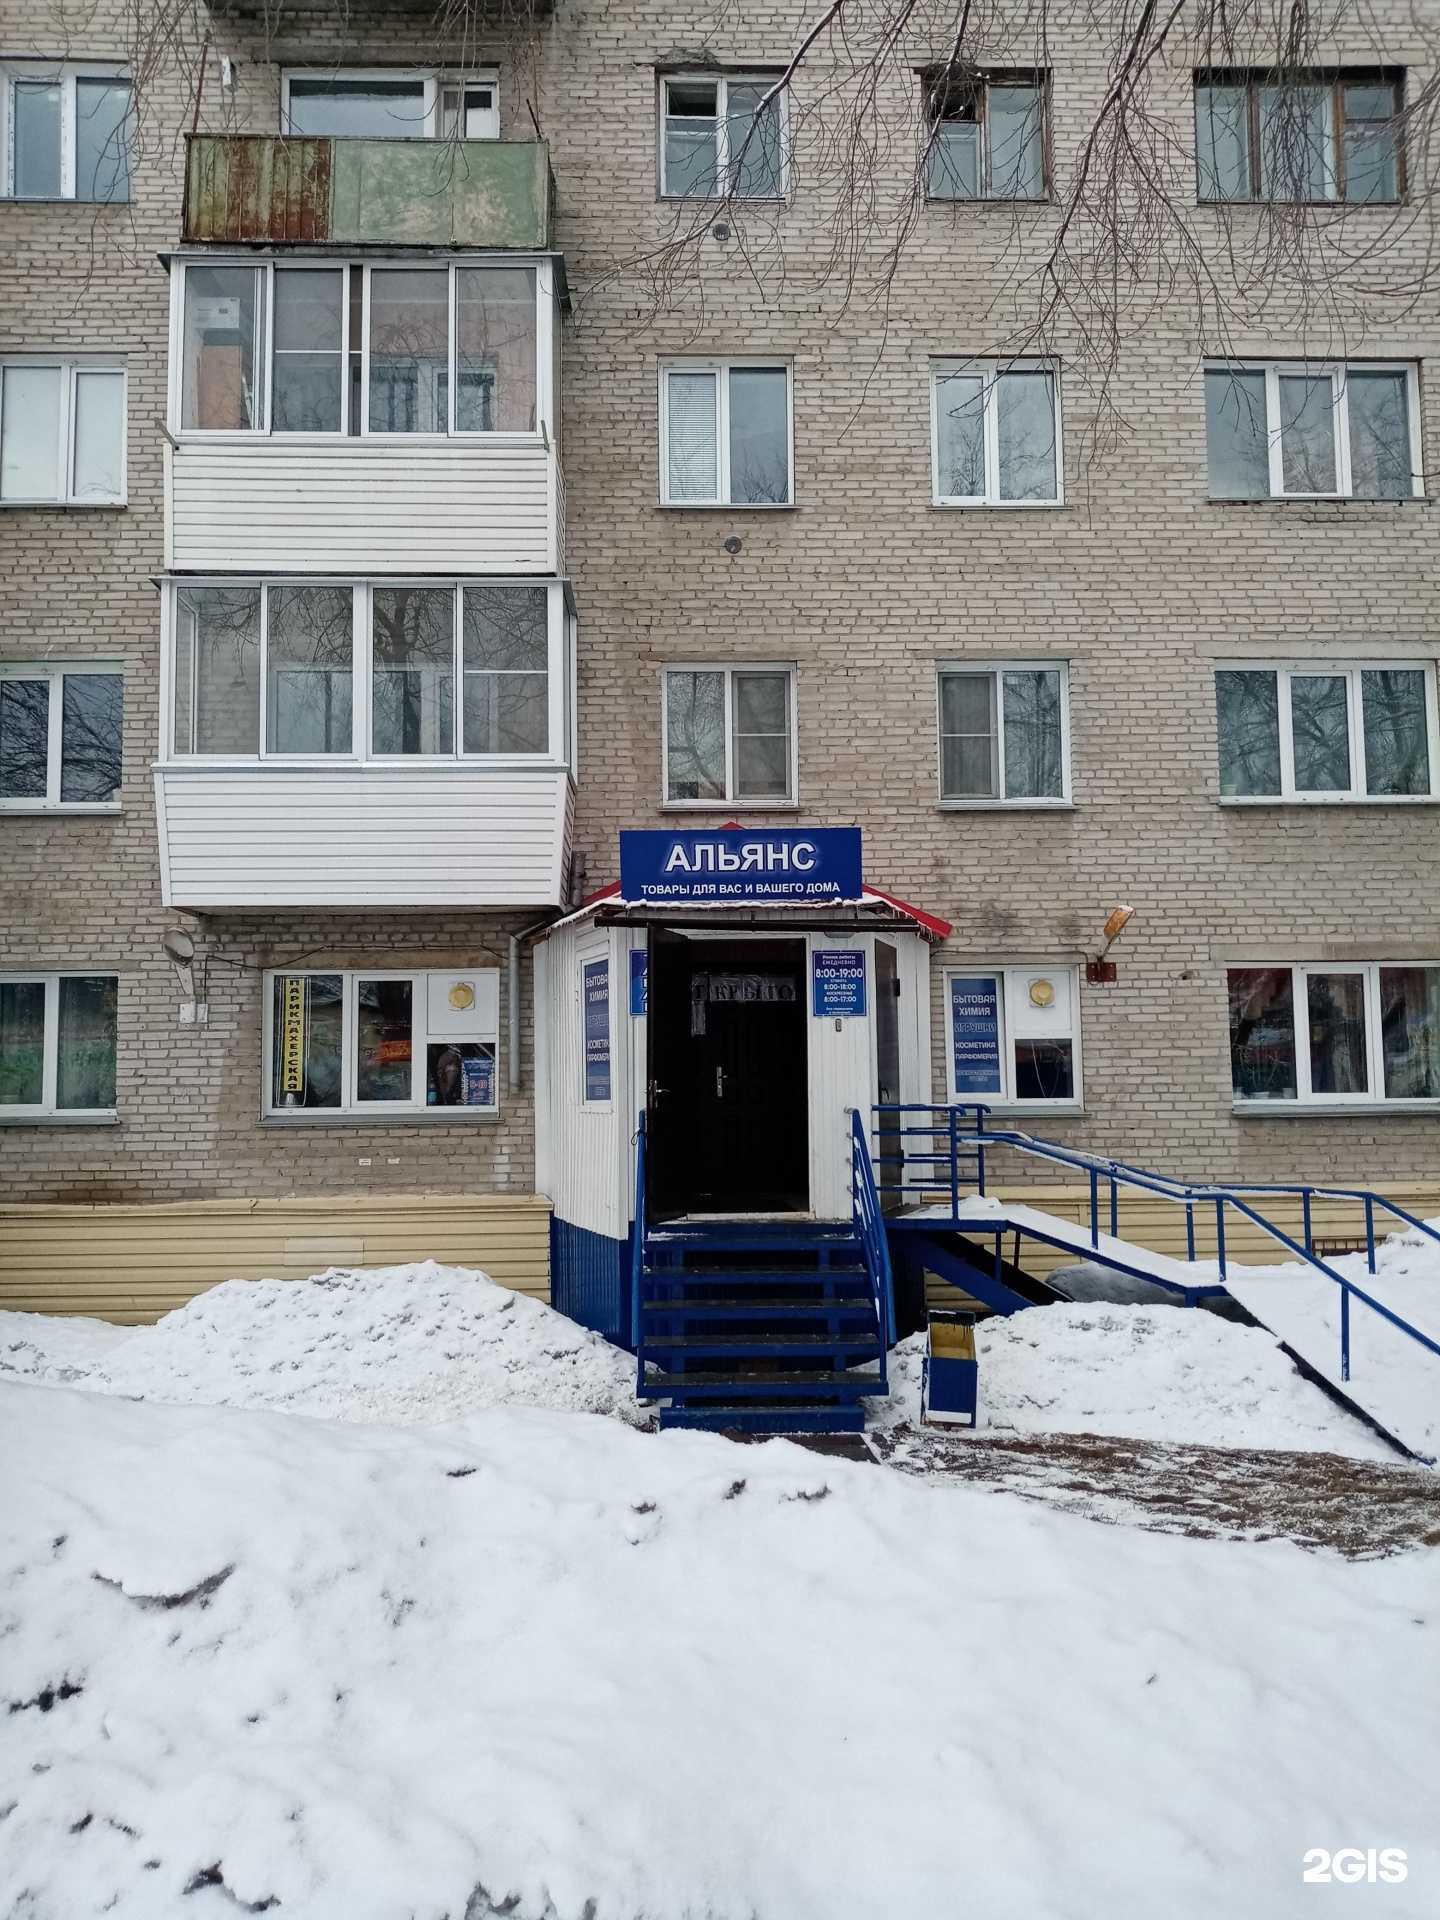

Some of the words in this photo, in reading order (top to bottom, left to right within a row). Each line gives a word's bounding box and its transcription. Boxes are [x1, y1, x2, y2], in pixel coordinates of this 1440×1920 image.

[665, 843, 816, 872] АЛЬЯНС
[641, 884, 690, 895] ТОВАРЫ
[692, 884, 716, 896] ДЛЯ
[719, 884, 742, 894] ВАС
[745, 883, 753, 893] И
[756, 883, 804, 893] ВАШЕГО
[806, 882, 840, 894] ДОМА
[816, 968, 863, 978] 8:00-19:00
[586, 974, 608, 988] БЫТОВА
[953, 995, 996, 1004] БЫТОВАЯ
[958, 1007, 991, 1016] ХИМИЯ
[287, 980, 300, 1090] ПАРИКМАХЕРСКАЯ
[955, 1041, 996, 1049] КОСМЕТИКА
